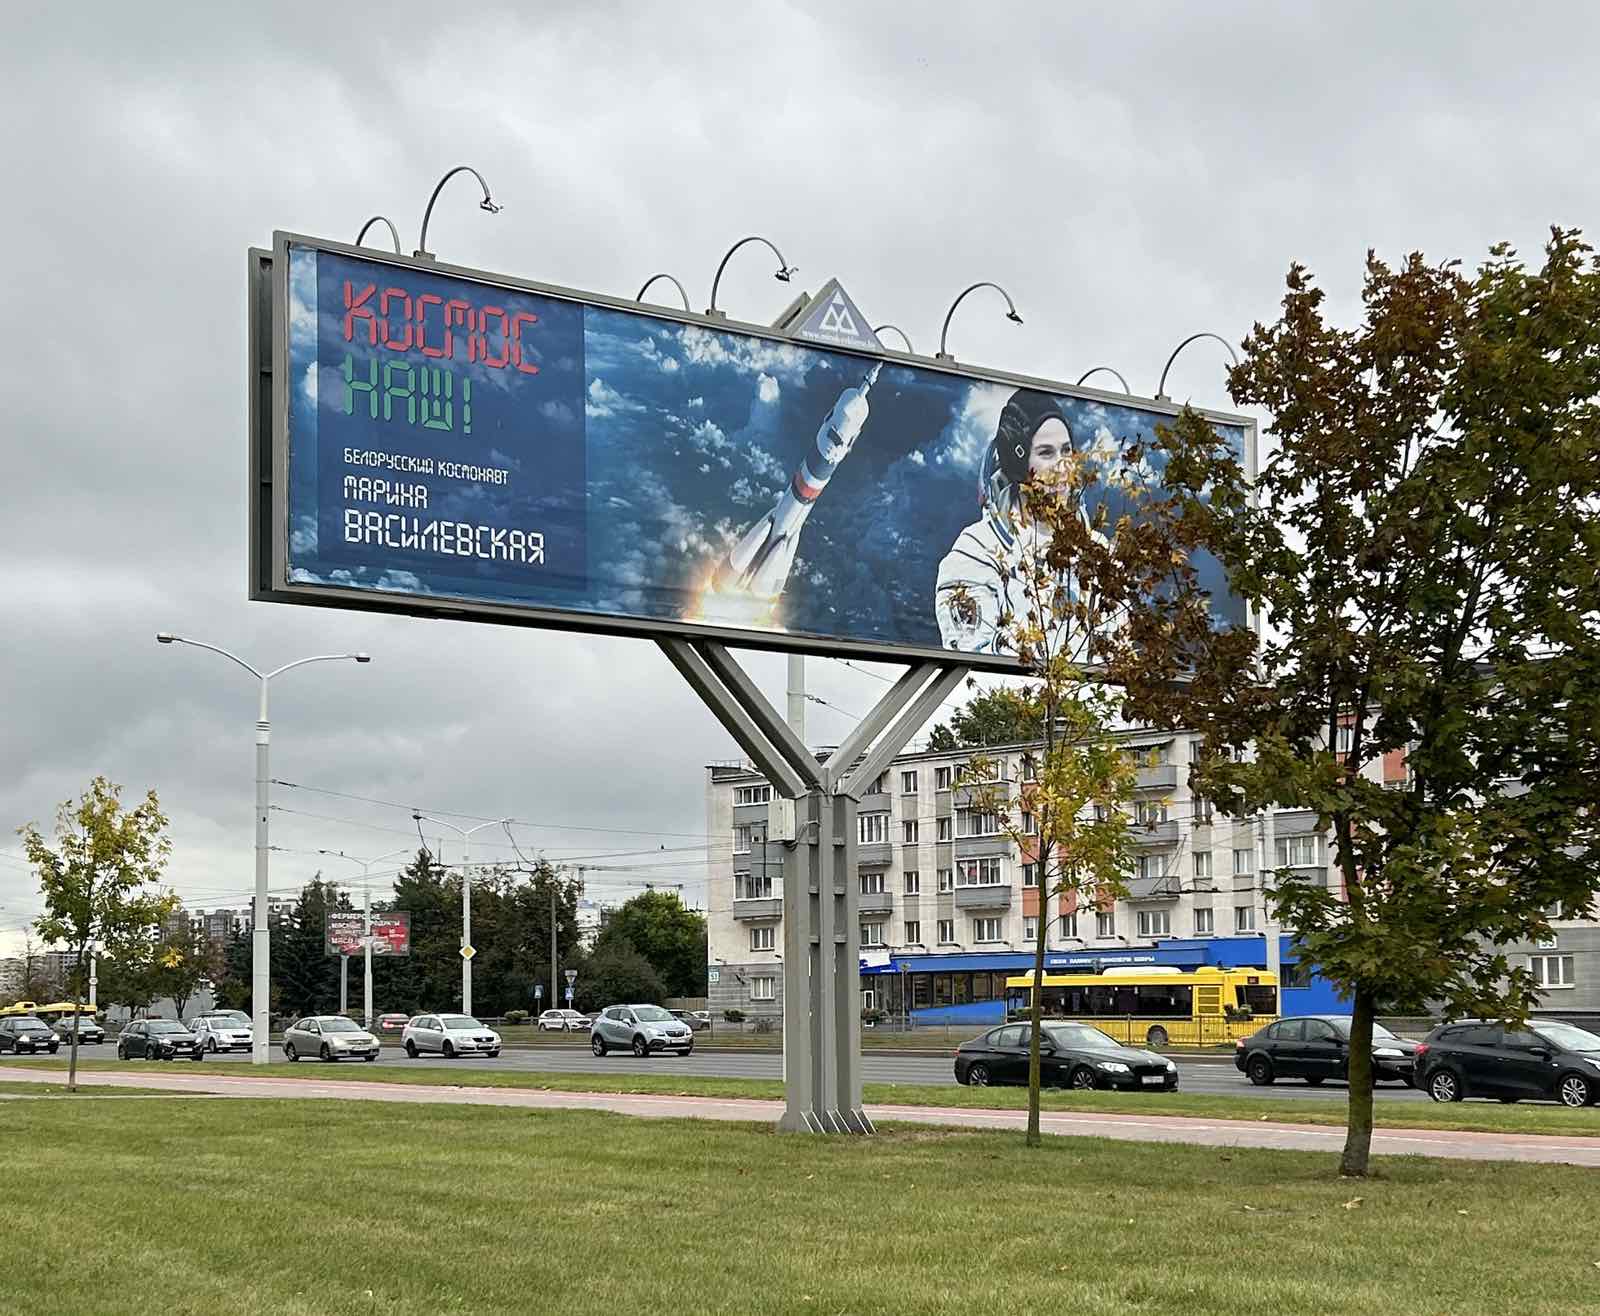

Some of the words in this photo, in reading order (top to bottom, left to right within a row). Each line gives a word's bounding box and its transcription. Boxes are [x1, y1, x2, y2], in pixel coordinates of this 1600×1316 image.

[343, 279, 540, 375] КОСМОС
[344, 353, 473, 435] НАШ!
[343, 475, 429, 509] МАРИНА
[344, 448, 434, 475] БЕЛОРУССКИЙ
[437, 461, 509, 485] КОСМОНАВТ
[343, 508, 545, 565] ВАСИЛЕВСКАЯ
